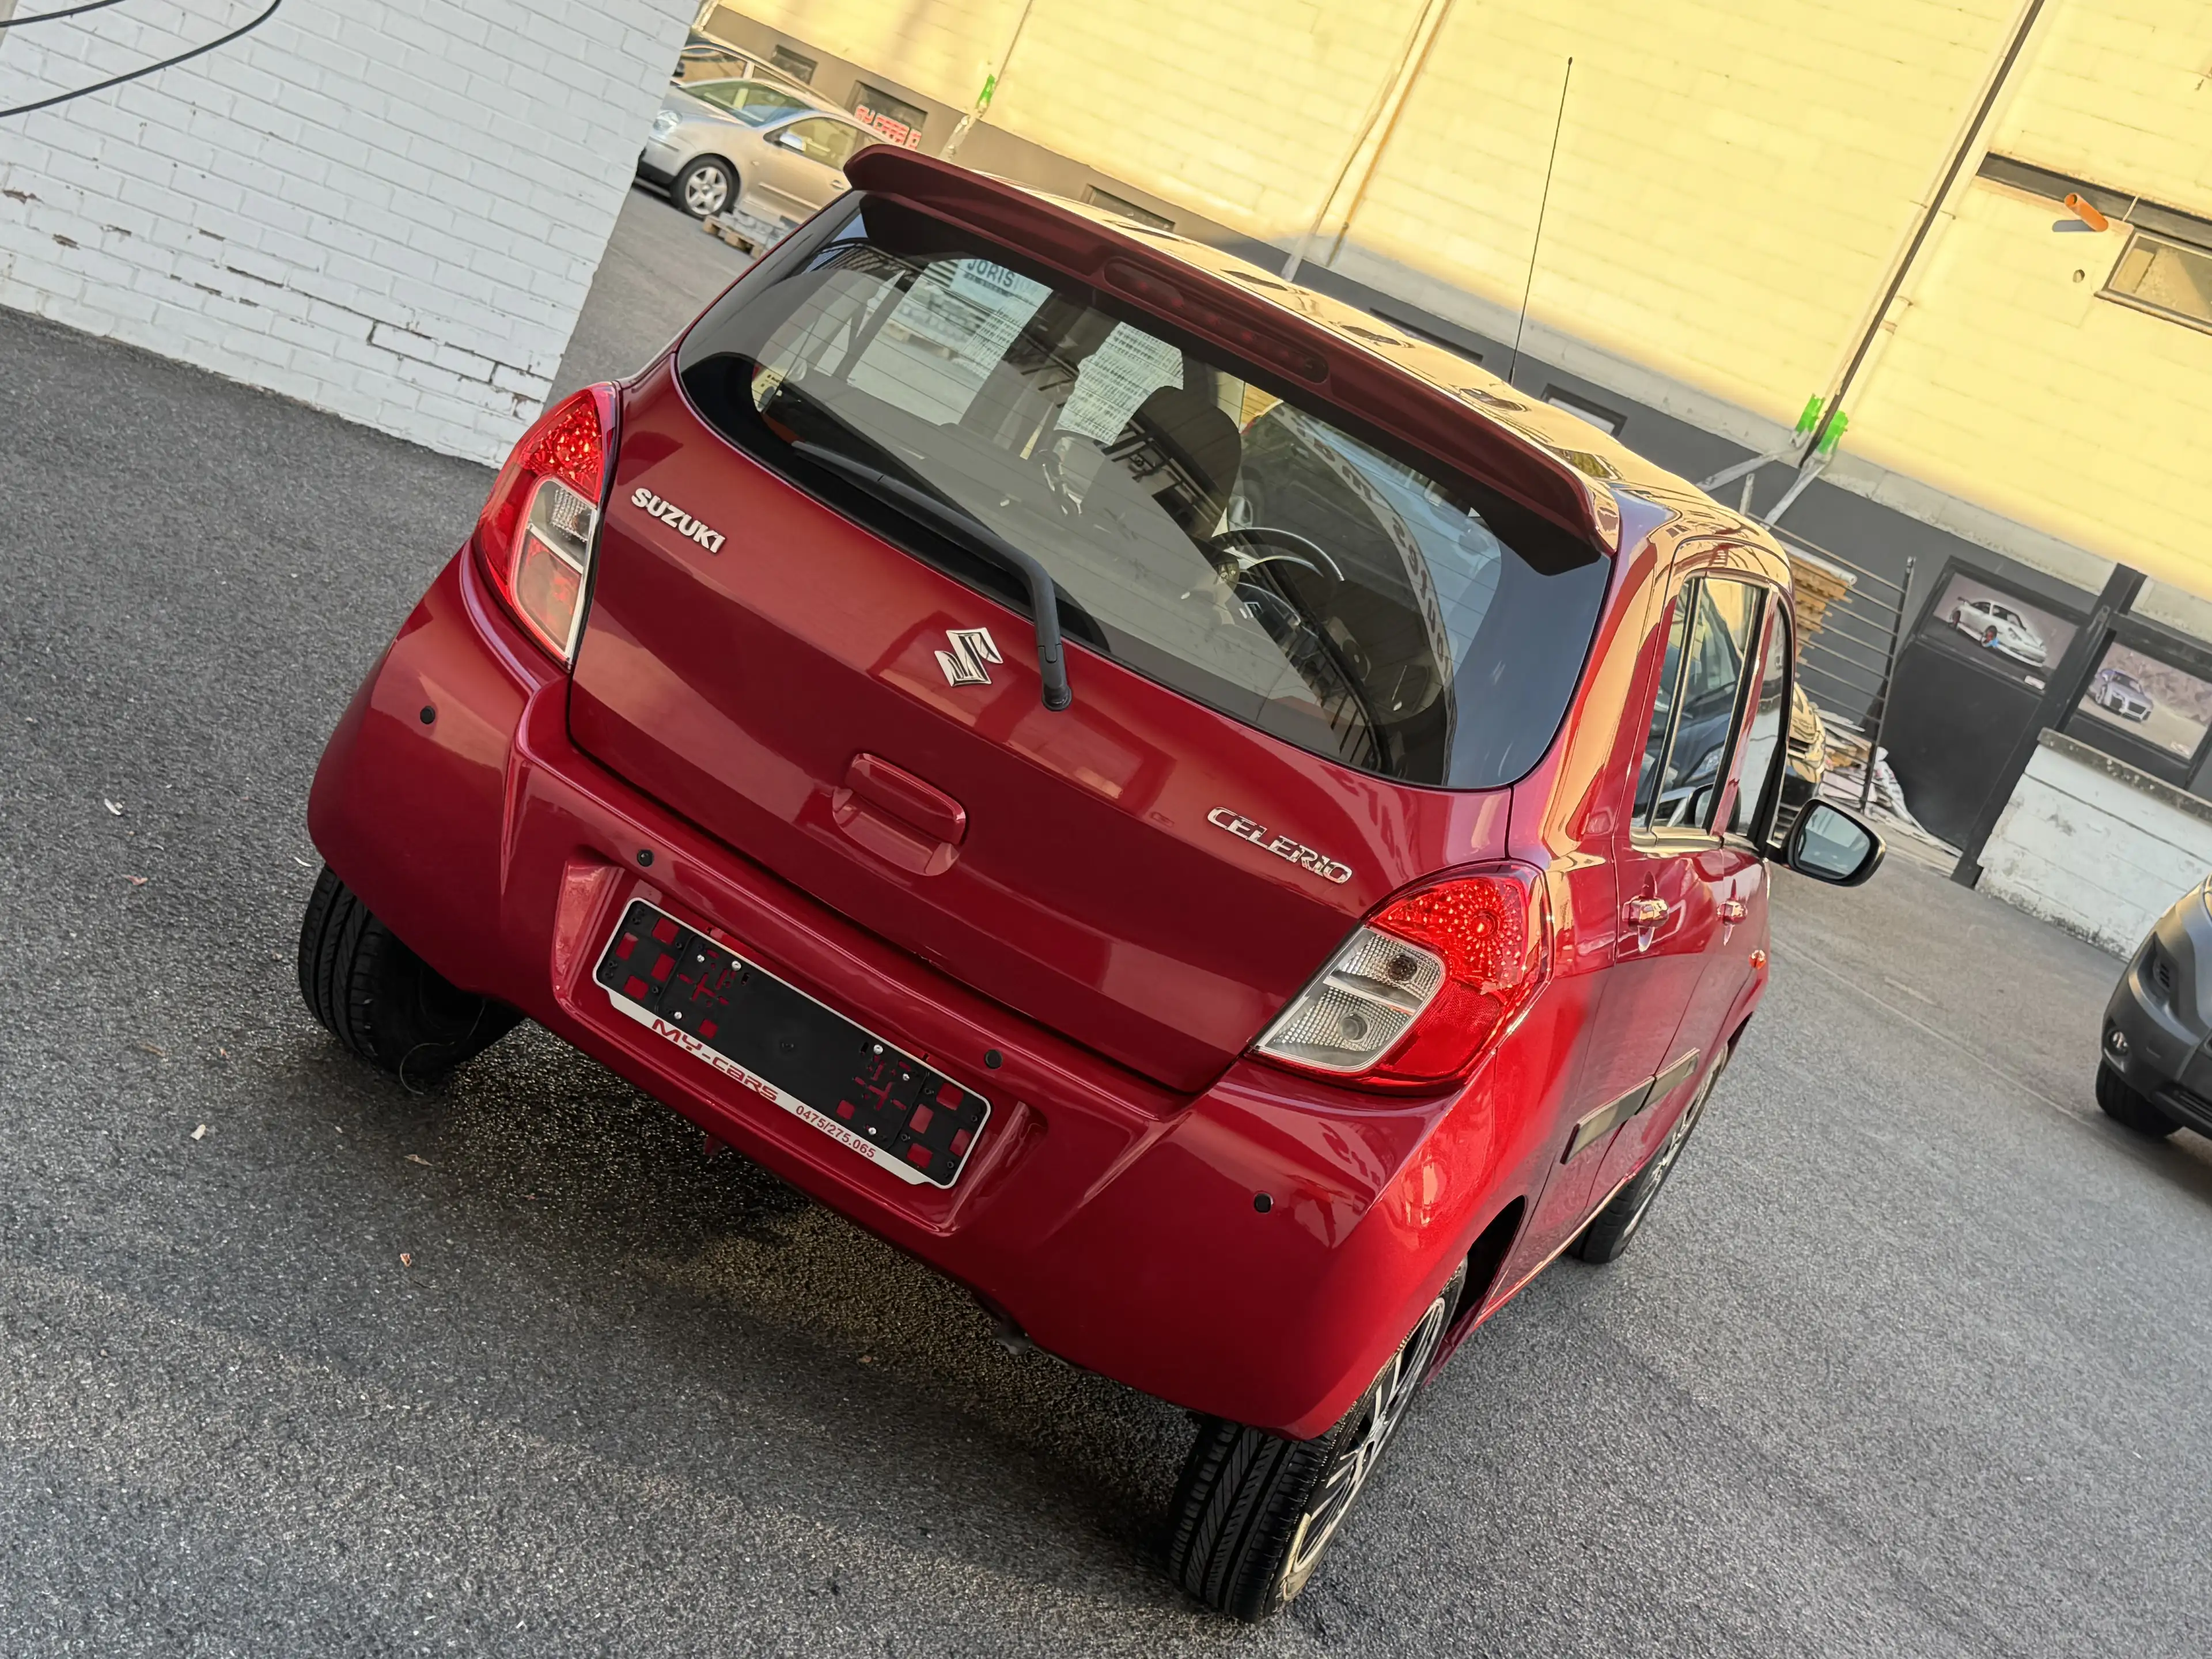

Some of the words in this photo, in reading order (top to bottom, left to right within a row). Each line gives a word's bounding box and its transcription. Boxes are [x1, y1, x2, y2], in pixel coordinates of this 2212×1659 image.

[631, 488, 726, 553] SUZUKI
[1207, 806, 1353, 884] CELERIO
[796, 1105, 876, 1158] 0475/275.065
